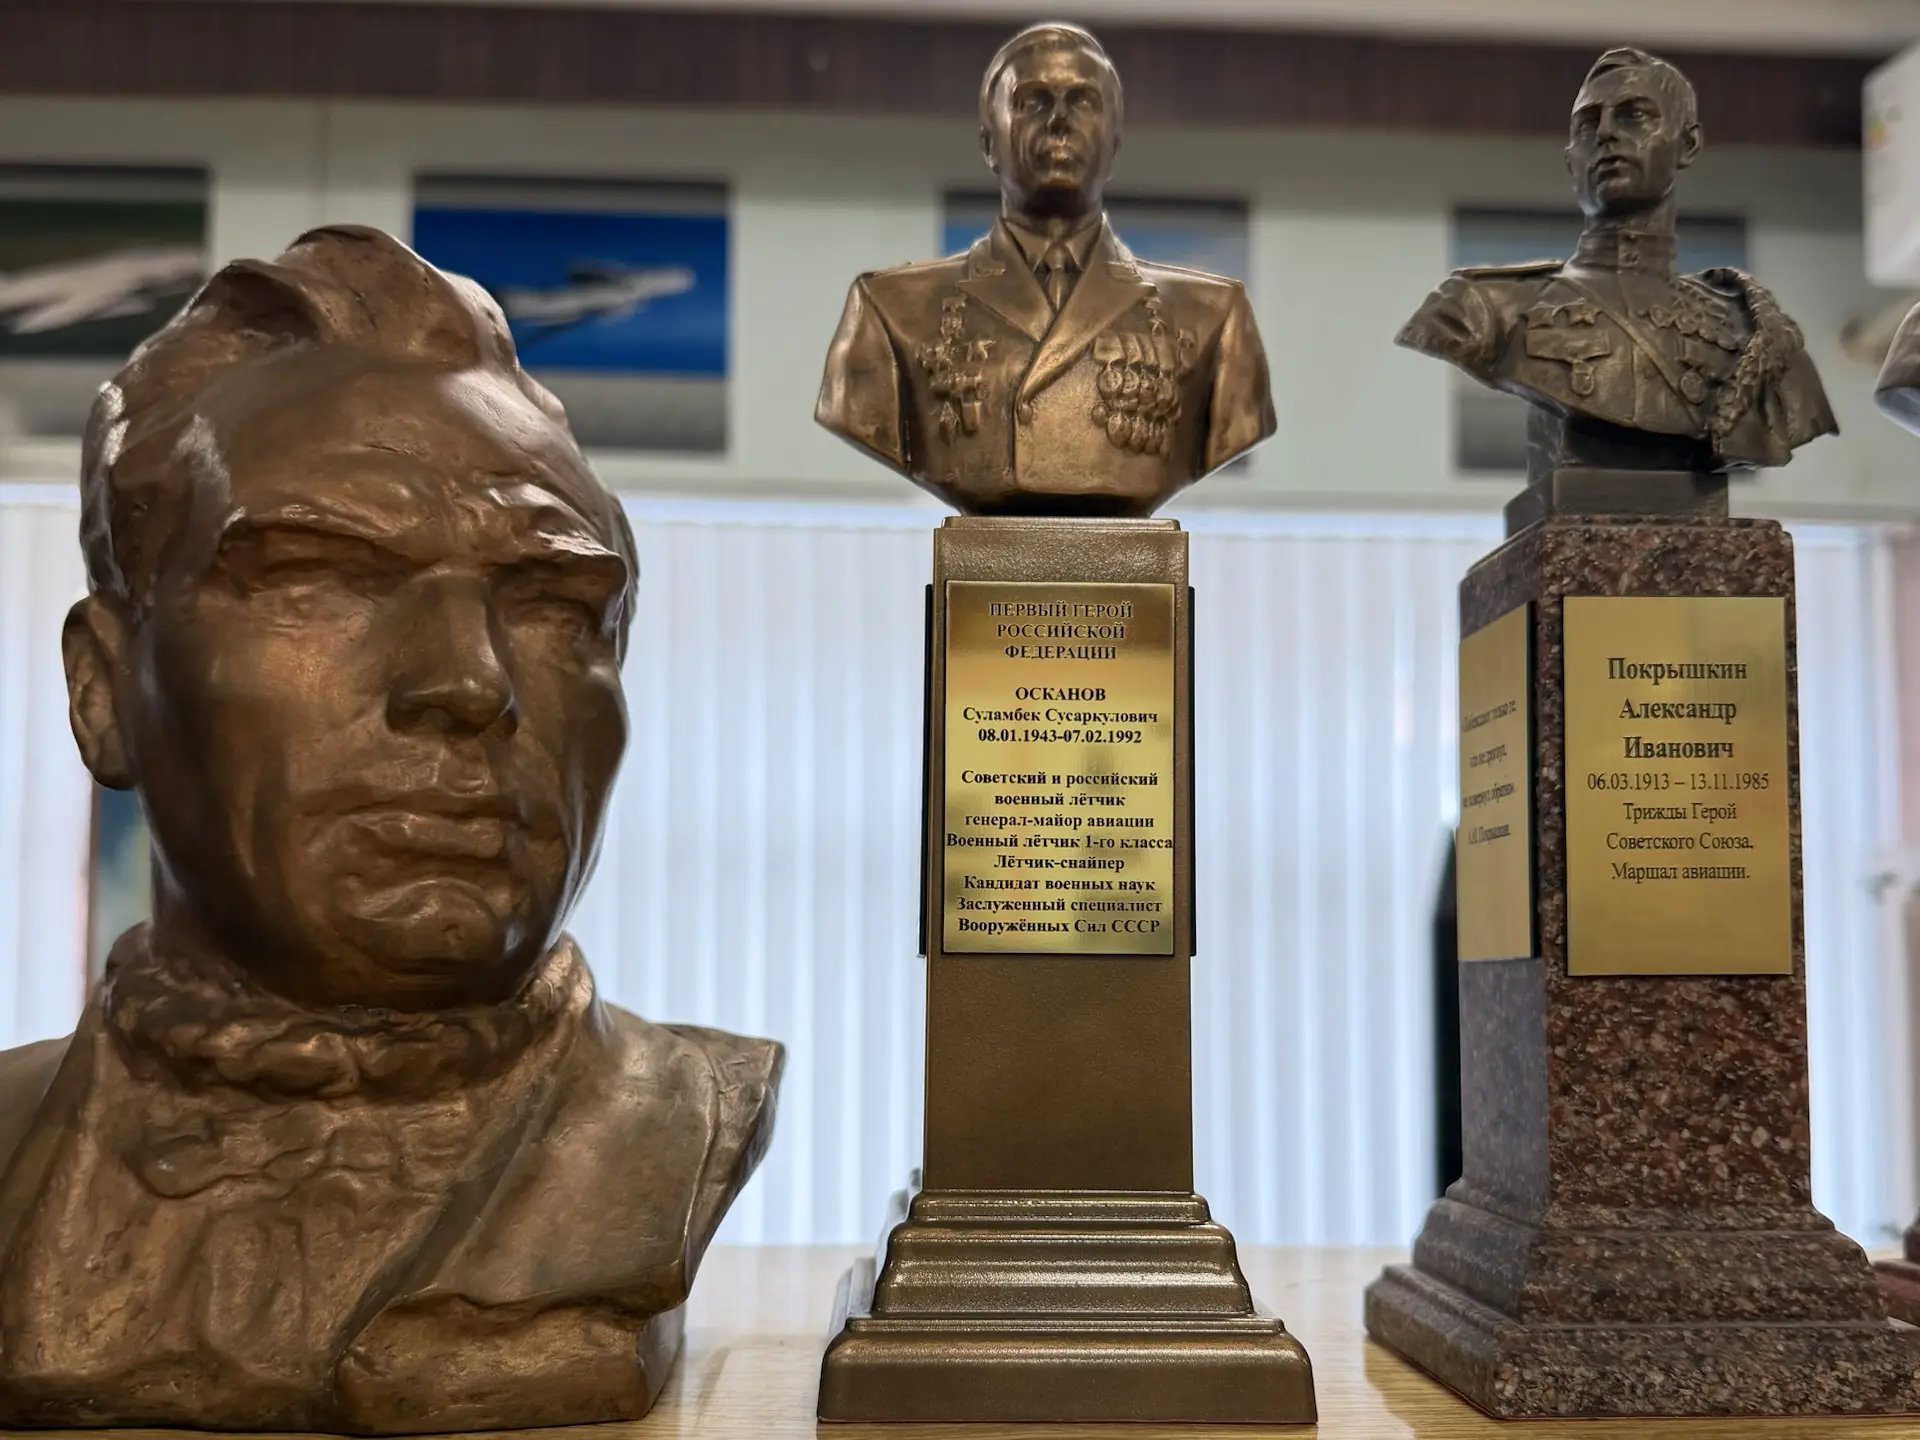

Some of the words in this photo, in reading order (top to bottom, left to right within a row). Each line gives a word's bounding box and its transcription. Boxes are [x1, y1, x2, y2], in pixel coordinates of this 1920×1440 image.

[990, 600, 1068, 617] ПЕРВЫЙ
[1073, 601, 1132, 618] ГЕРОЙ
[997, 622, 1125, 639] РОССИЙСКОЙ
[1005, 646, 1116, 660] ФЕДЕРАЦИИ
[1607, 658, 1747, 685] Покрышкин
[1015, 687, 1106, 700] ОСКАНОВ
[963, 708, 1040, 724] Суламбек
[1045, 709, 1157, 725] Сусаркулович
[1619, 699, 1737, 724] Александр
[978, 728, 1142, 743] 08.01.1943-07.02.1992
[1623, 736, 1734, 759] Иванович
[962, 770, 1046, 784] Советский
[1052, 774, 1061, 784] и
[1067, 773, 1158, 788] российский
[1587, 772, 1669, 790] 06.03.1913
[1690, 772, 1768, 790] 13.11.1985
[995, 793, 1064, 805] военный
[1069, 793, 1125, 805] лётчик
[1623, 802, 1687, 824] Трижды
[1692, 802, 1737, 823] Герой
[965, 815, 1082, 829] генерал-майор
[1087, 818, 1154, 828] авиации
[947, 834, 1018, 846] Военный
[1023, 834, 1080, 847] лётчик
[1086, 835, 1115, 849] 1-го
[1120, 839, 1173, 848] класса
[1606, 832, 1694, 850] Советского
[1699, 832, 1753, 850] Союза.
[994, 855, 1124, 872] Лётчик-снайпер
[1611, 863, 1677, 883] Маршал
[1682, 865, 1750, 880] авиации.
[964, 876, 1040, 890] Кандидат
[1046, 880, 1113, 890] военных
[1119, 880, 1155, 894] наук
[957, 897, 1065, 913] Заслуженный
[1071, 901, 1162, 913] специалист
[959, 918, 1069, 934] Вооружённых
[1075, 920, 1106, 932] Сил
[1111, 920, 1160, 933] СССР
